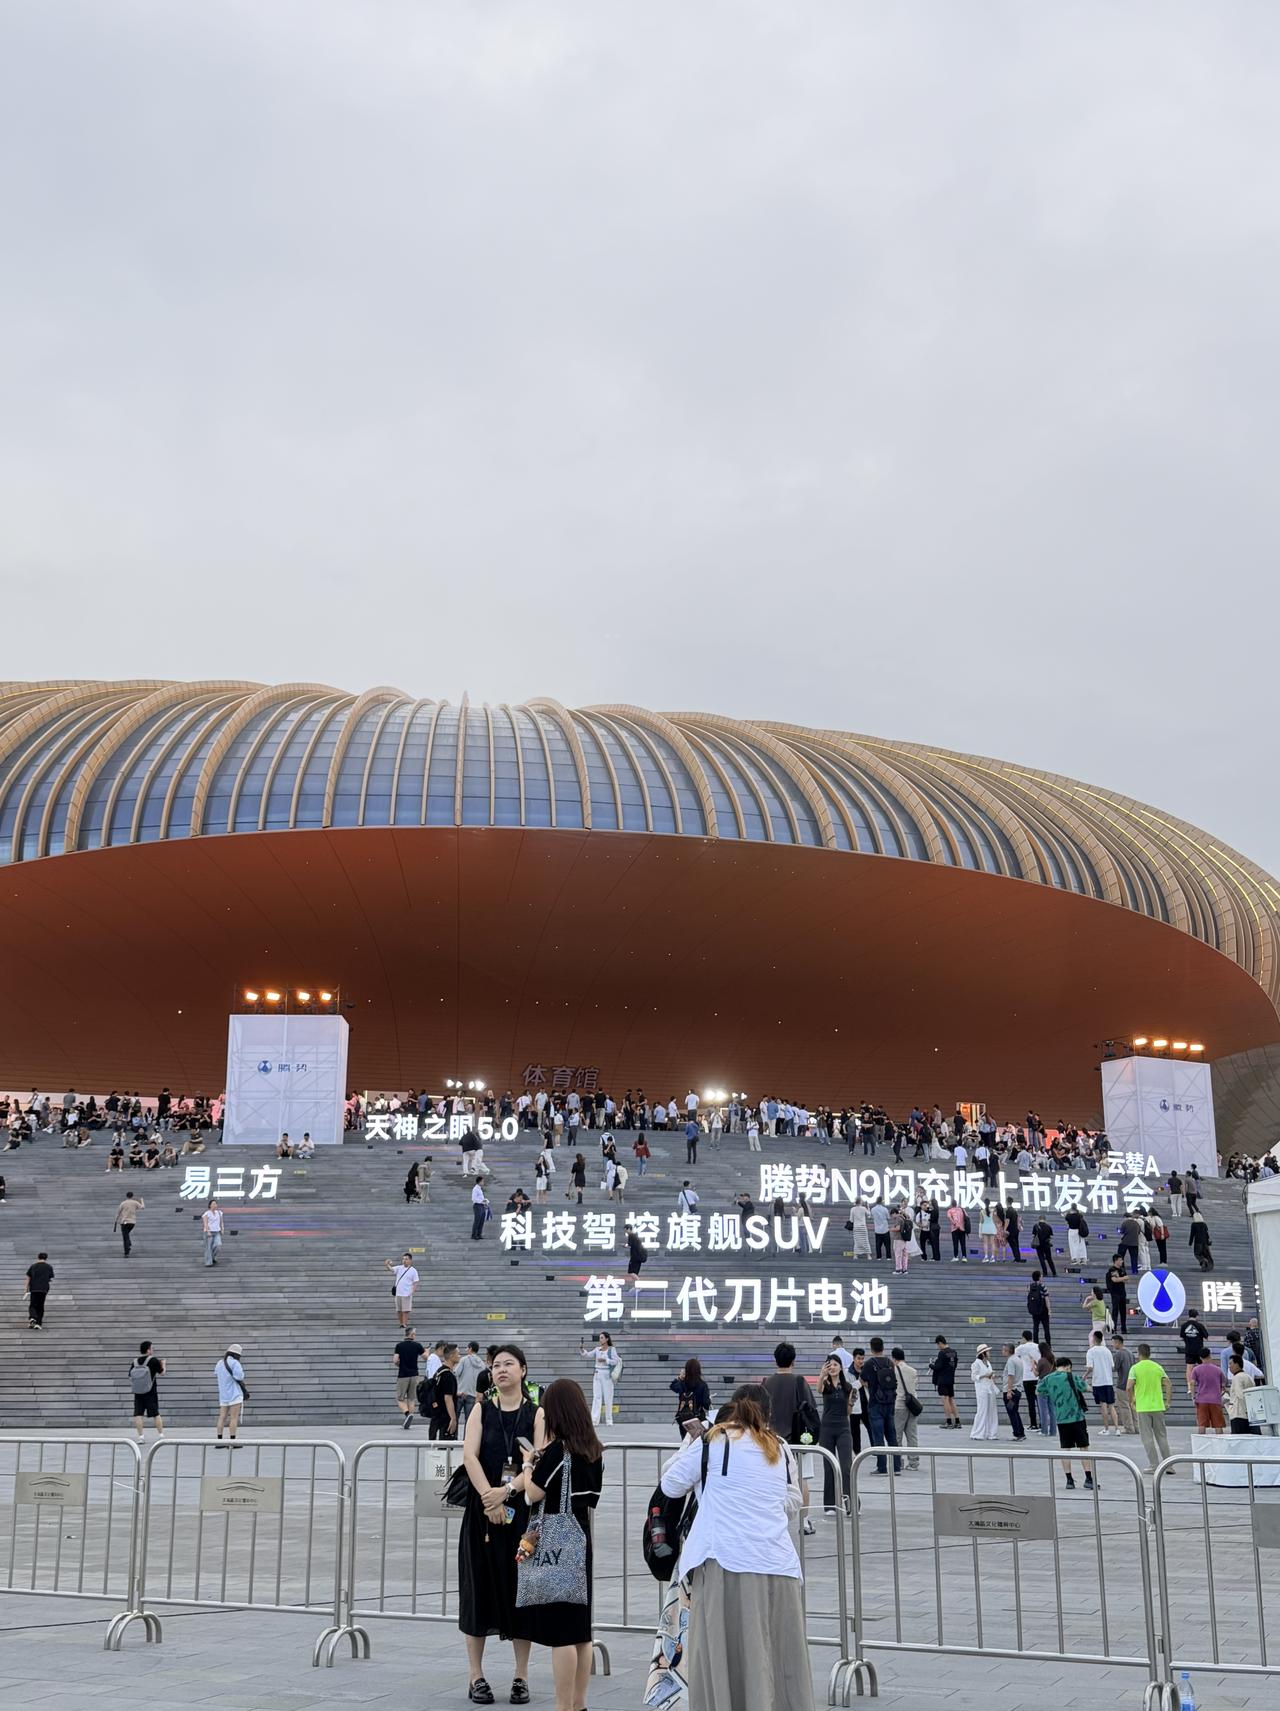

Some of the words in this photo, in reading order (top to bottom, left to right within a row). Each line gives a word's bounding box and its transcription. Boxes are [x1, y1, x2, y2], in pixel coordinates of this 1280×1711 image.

[522, 1062, 600, 1089] 体育馆
[364, 1113, 519, 1141] 天神之眼5.0
[179, 1165, 282, 1201] 易三方
[757, 1163, 1155, 1214] 腾势N9闪充版上市发布会
[498, 1210, 830, 1252] 科技驾控旗舰SUV
[582, 1274, 893, 1324] 第二代刀片电池
[1201, 1281, 1262, 1313] 腾
